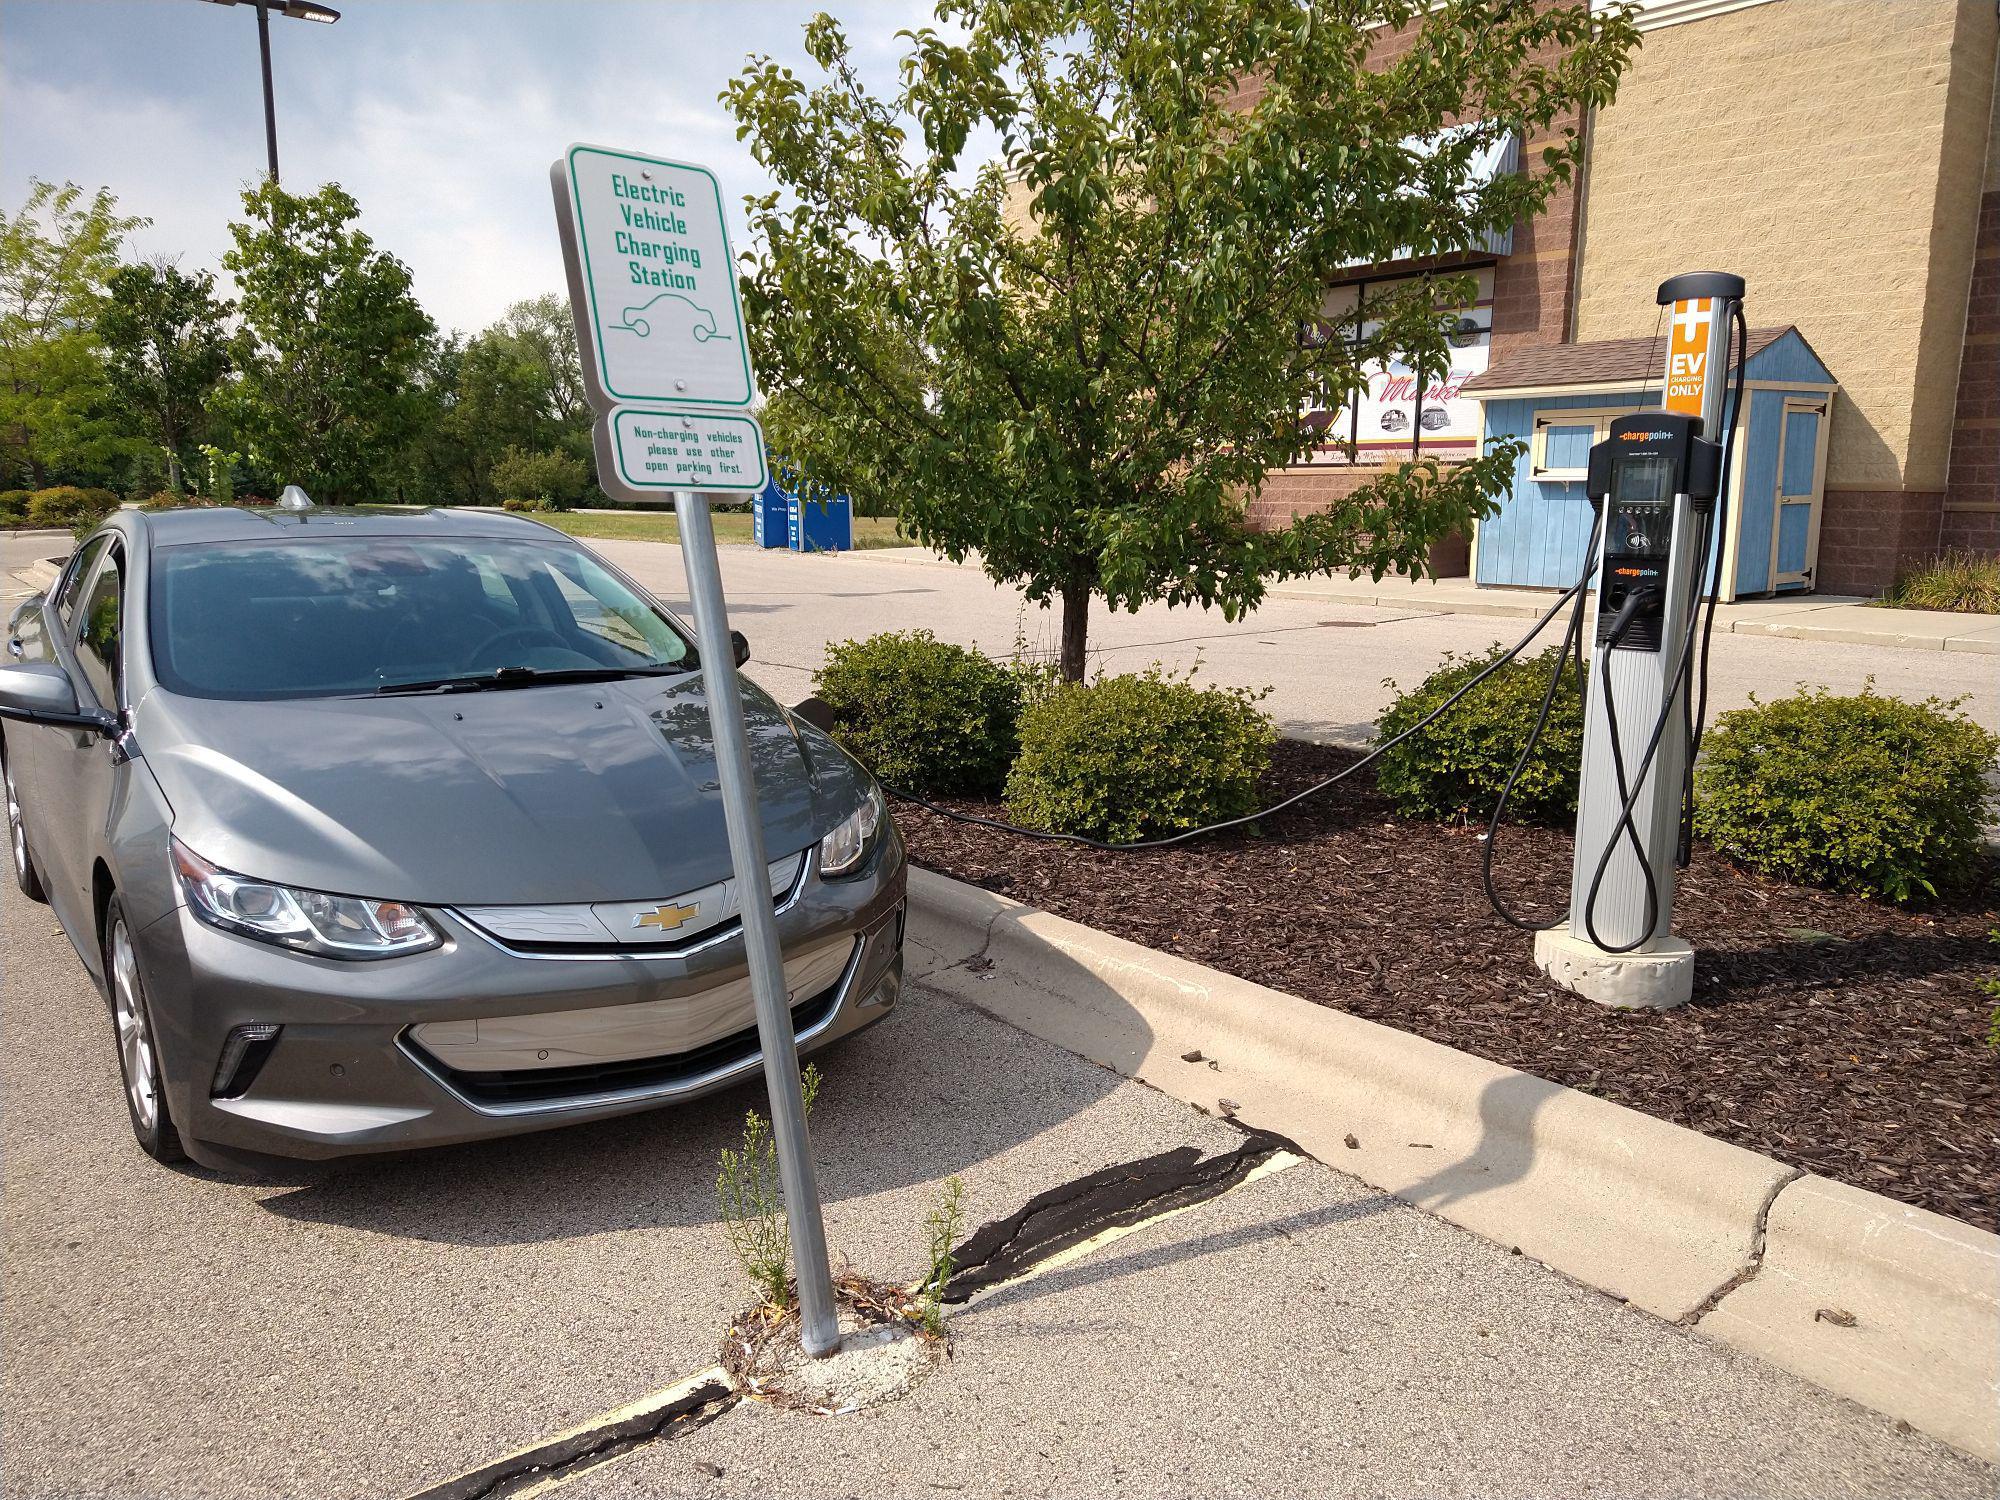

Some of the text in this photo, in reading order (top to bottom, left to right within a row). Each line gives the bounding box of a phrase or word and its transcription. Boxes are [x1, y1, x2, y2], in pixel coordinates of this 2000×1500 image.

[612, 174, 685, 207] Electric
[620, 203, 687, 235] Vehicle
[615, 231, 701, 268] Charging
[629, 261, 696, 290] Station
[1671, 352, 1706, 375] EV
[1671, 375, 1703, 383] CHARGING
[1669, 383, 1703, 397] ONLY
[633, 425, 743, 443] Non-charging vehicles
[647, 443, 735, 458] please use other
[645, 460, 743, 475] open parking first.
